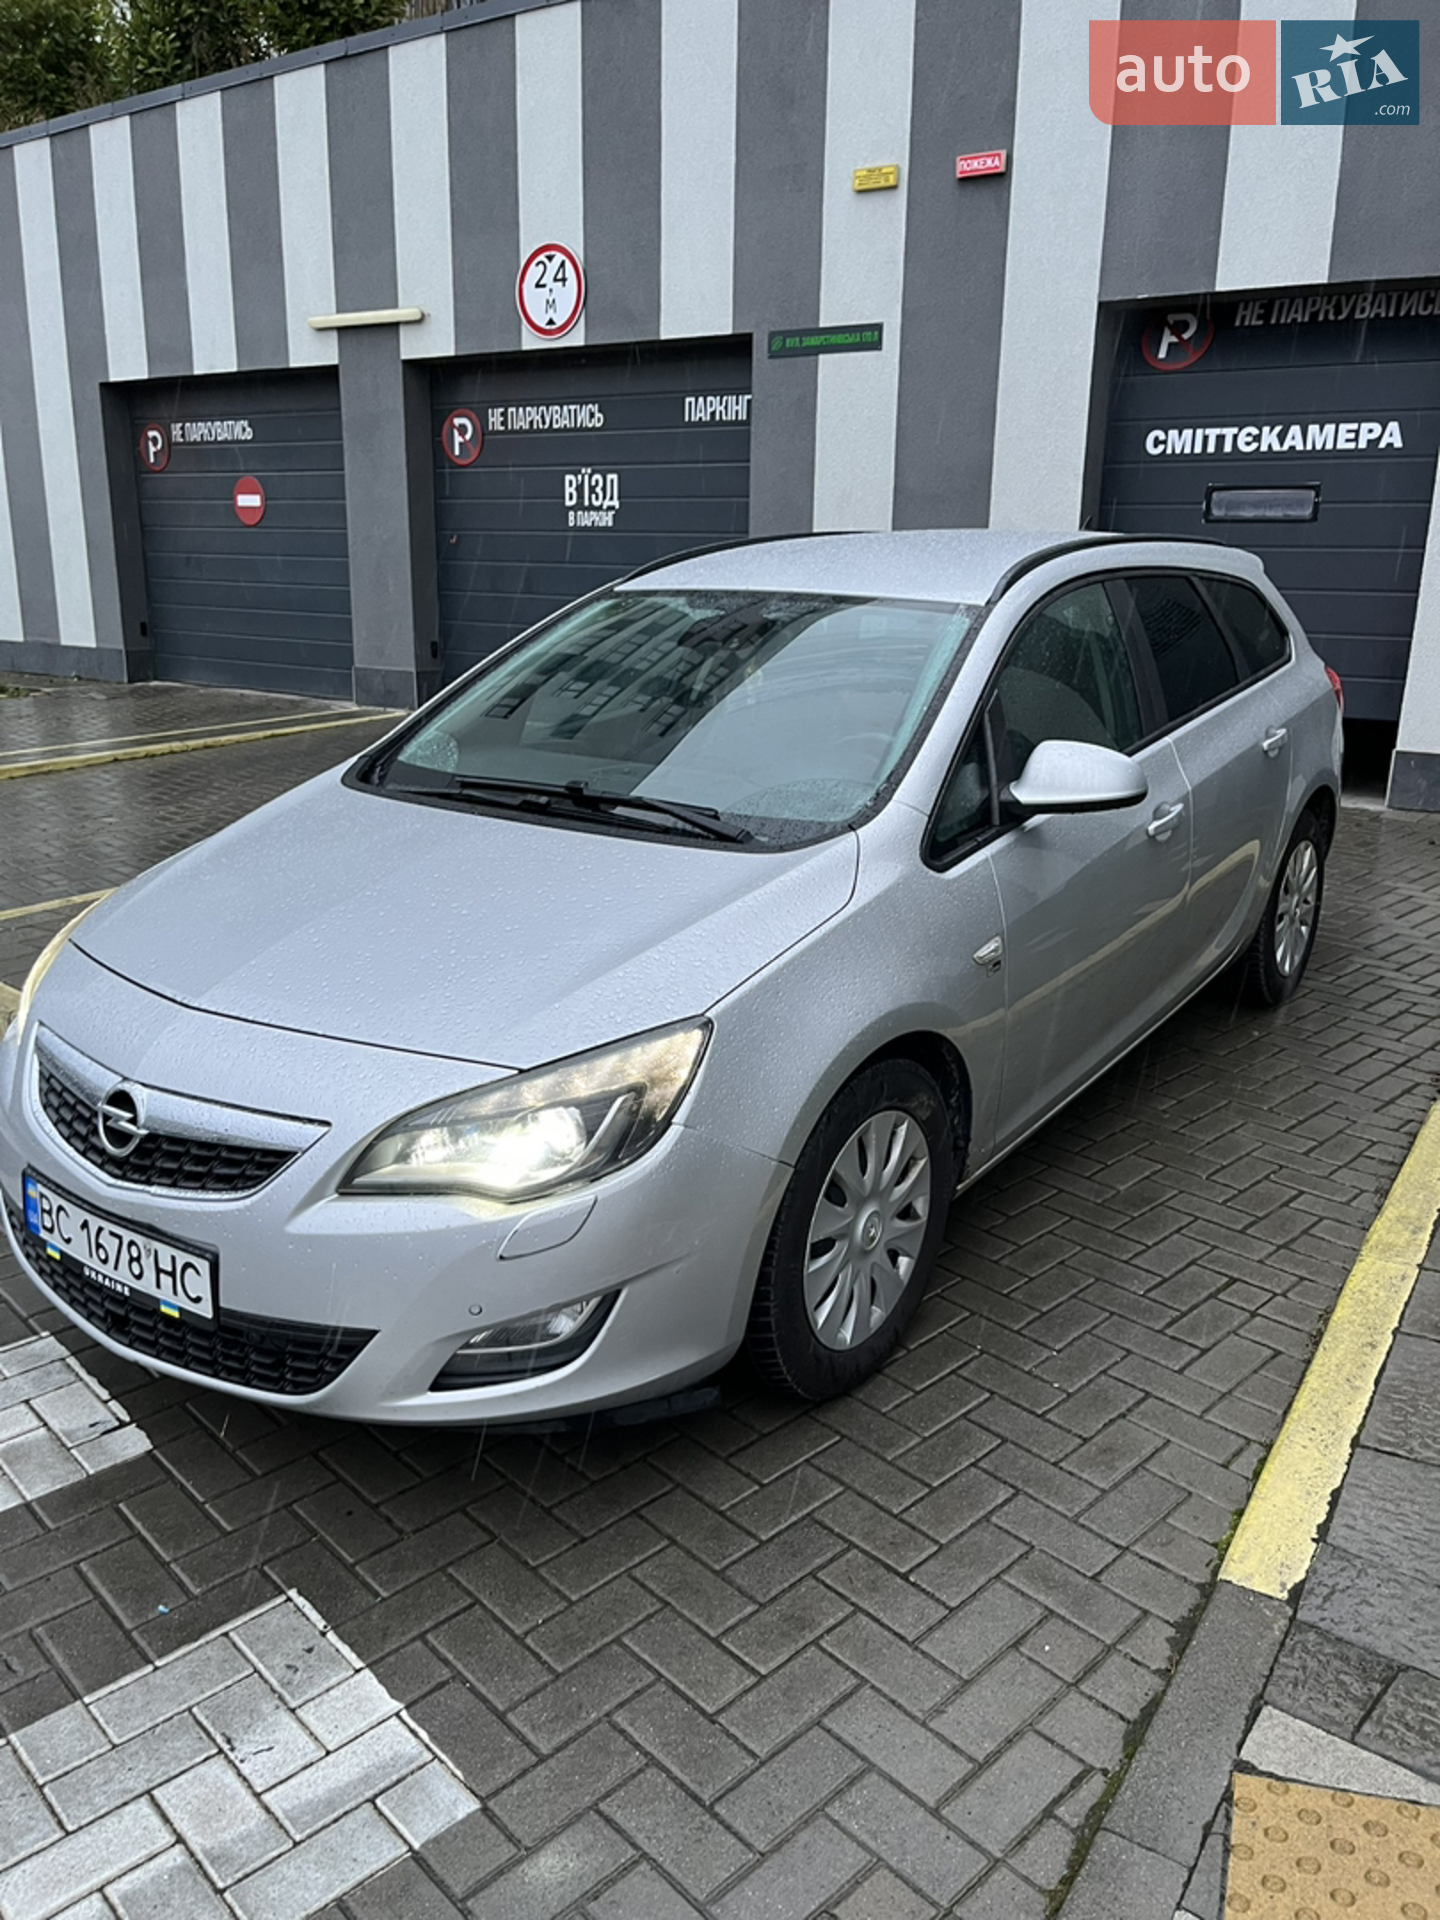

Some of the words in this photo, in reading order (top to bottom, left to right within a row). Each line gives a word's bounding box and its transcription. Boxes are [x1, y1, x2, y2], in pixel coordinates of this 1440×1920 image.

[1235, 300, 1265, 327] НЕ
[488, 408, 505, 431] НЕ
[508, 403, 604, 430] ПАРКУВАТИСЬ
[684, 395, 752, 422] ПАРКІНГ
[171, 422, 184, 443] НЕ
[185, 419, 253, 442] ПАРКУВАТИСЬ
[1145, 421, 1404, 456] СМІТТЄКАМЕРА
[568, 511, 575, 527] В
[577, 511, 616, 527] ПАРКІНГ
[39, 1191, 72, 1245] BC
[80, 1218, 144, 1281] 1678
[154, 1248, 203, 1304] HC
[83, 1265, 131, 1297] UKRAINE
